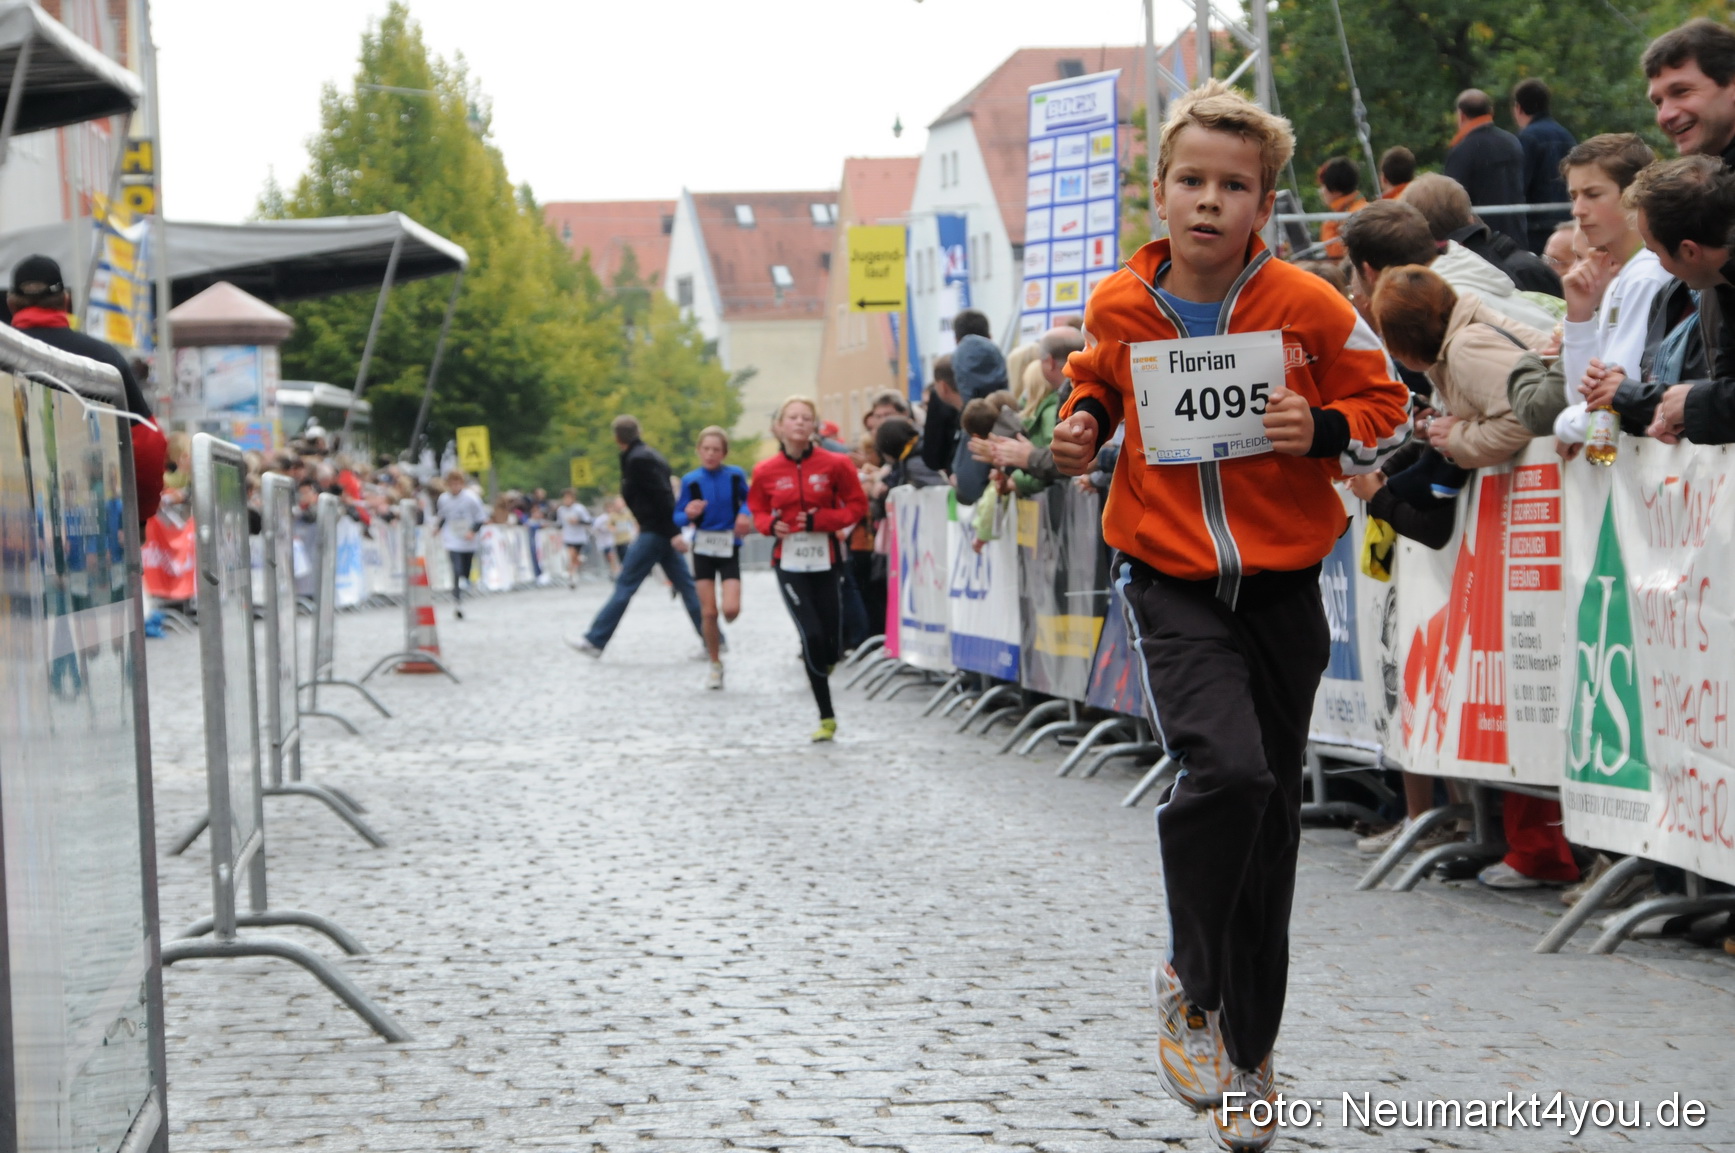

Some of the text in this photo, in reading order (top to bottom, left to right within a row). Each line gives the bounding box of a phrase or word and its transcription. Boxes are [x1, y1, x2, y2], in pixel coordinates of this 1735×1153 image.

[864, 265, 890, 278] lauf
[1169, 350, 1236, 374] Florian
[1140, 389, 1148, 407] J
[1174, 382, 1270, 422] 4095
[1156, 448, 1191, 459] BOCK
